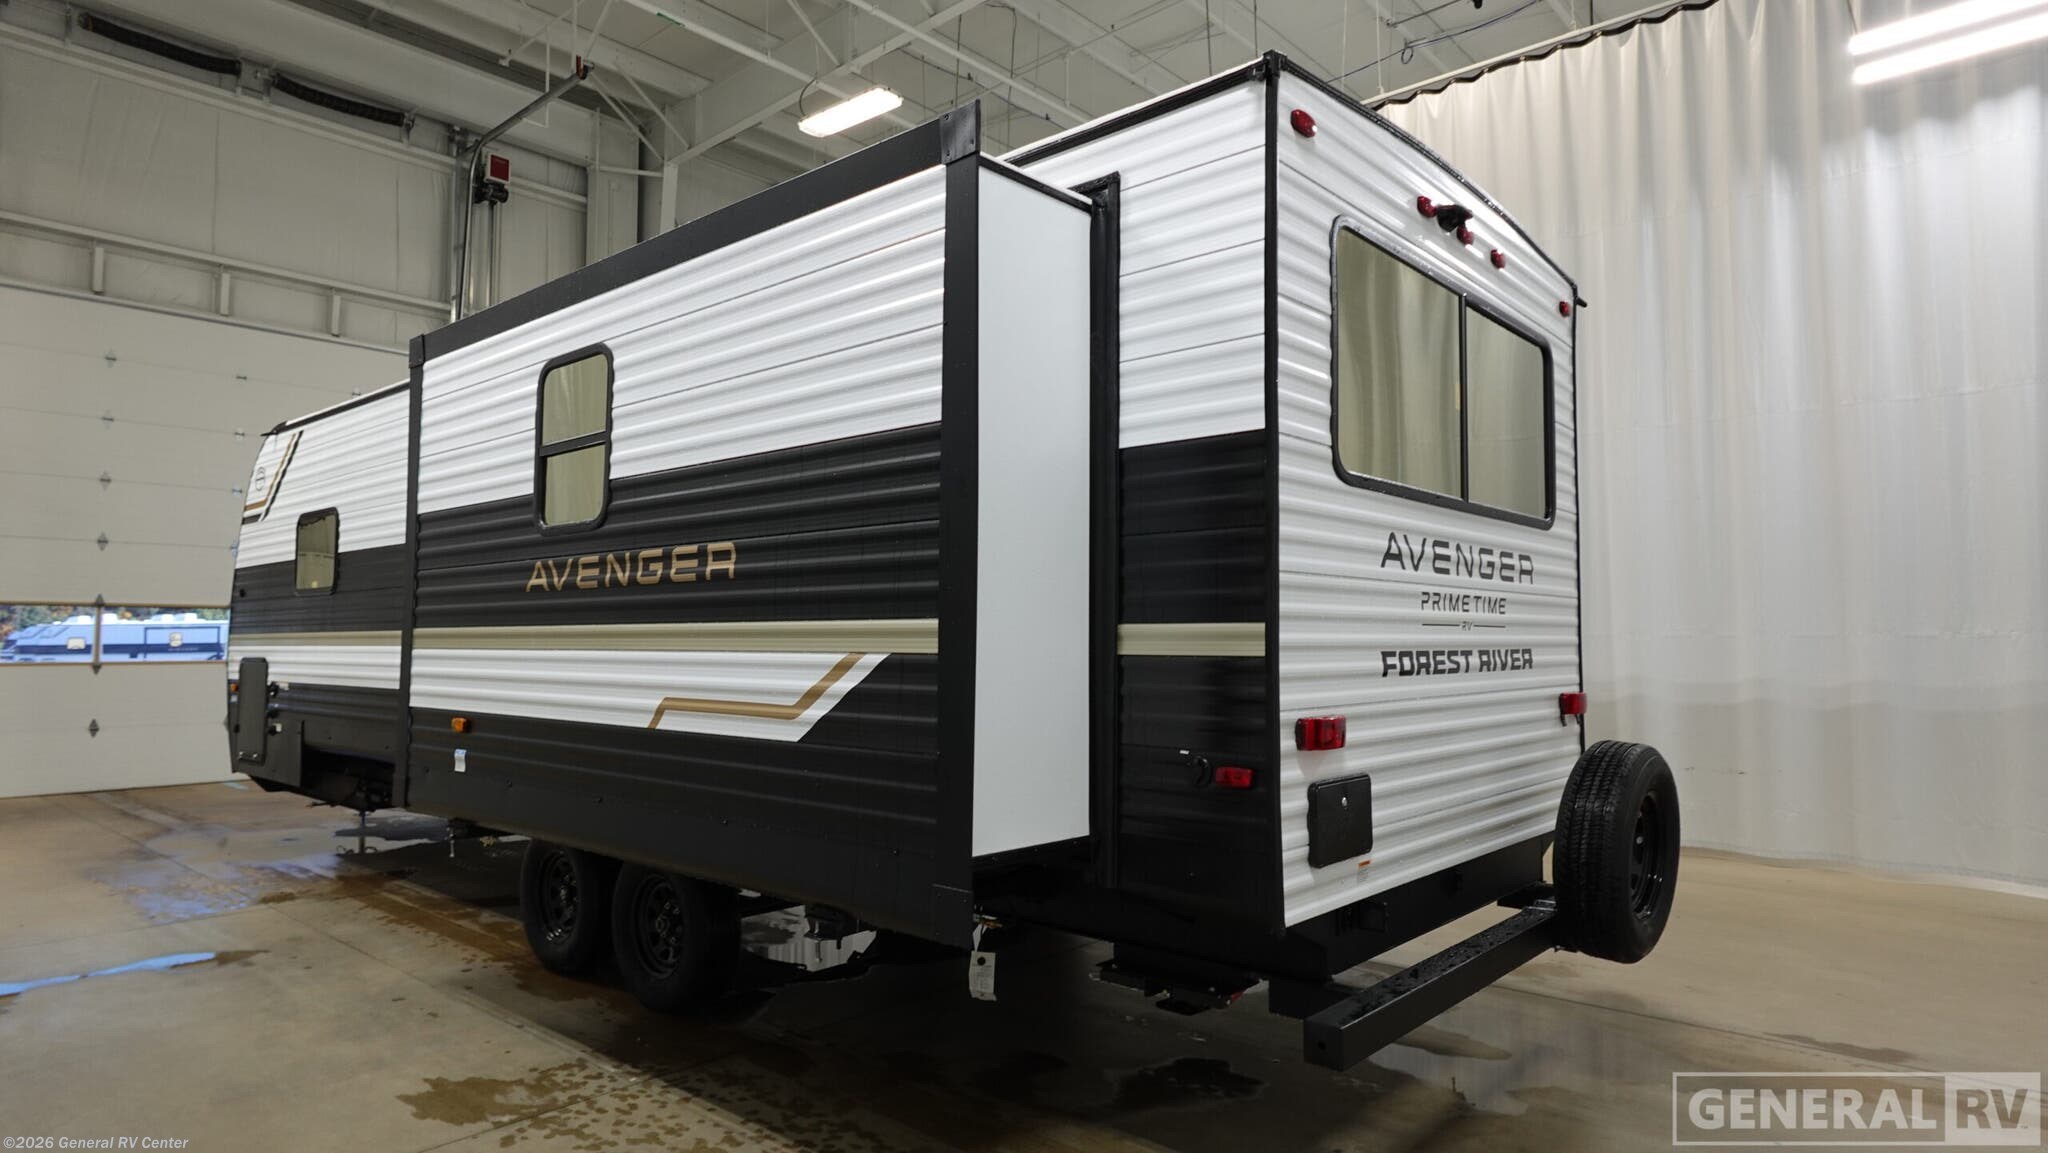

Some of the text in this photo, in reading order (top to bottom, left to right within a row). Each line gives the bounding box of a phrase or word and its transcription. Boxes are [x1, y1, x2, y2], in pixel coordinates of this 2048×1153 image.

[526, 541, 737, 593] AVENGER
[1381, 531, 1534, 584] AVENGER
[1461, 620, 1473, 631] RV
[1381, 648, 1534, 678] FOREST RIVER
